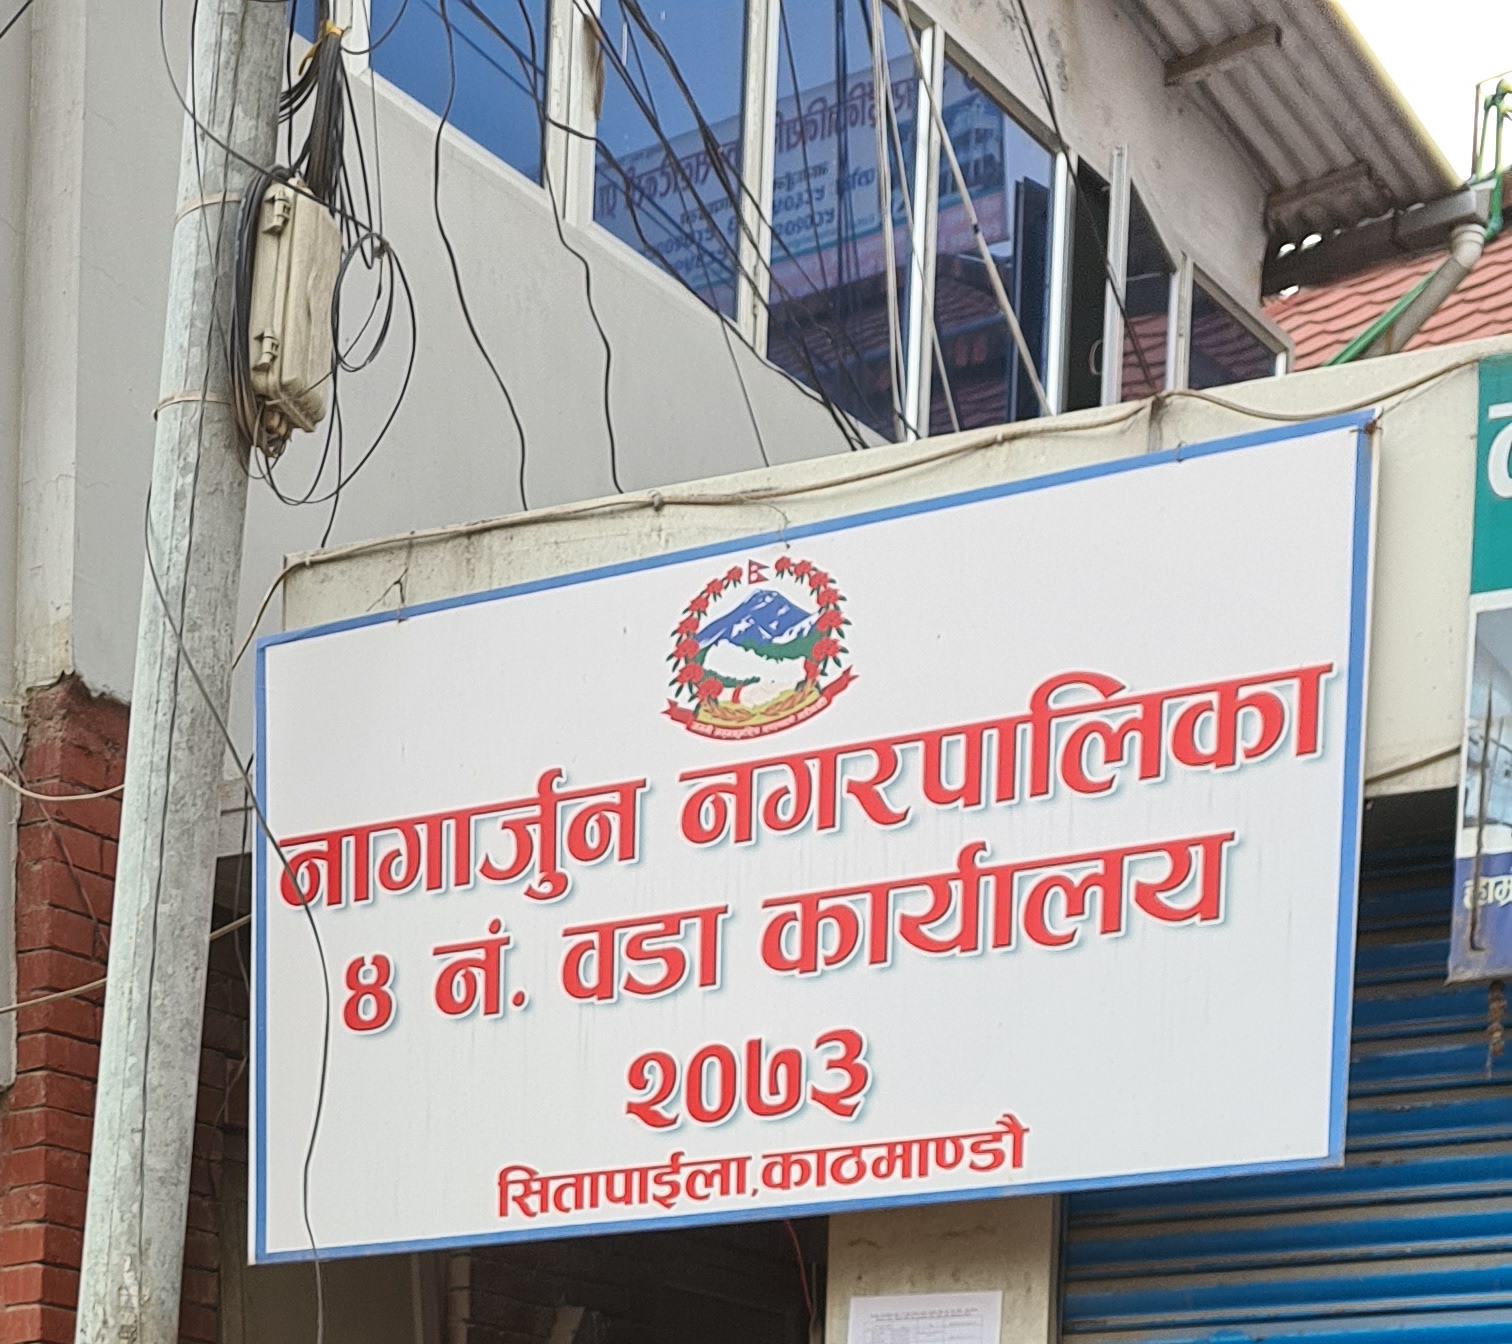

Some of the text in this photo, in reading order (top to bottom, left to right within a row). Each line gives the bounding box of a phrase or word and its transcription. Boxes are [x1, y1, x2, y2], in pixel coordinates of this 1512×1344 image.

[280, 663, 1333, 907] नागार्जुन नगरपालिका
[343, 954, 393, 1032] ४
[561, 904, 728, 1000] वडा
[761, 831, 1235, 974] कार्यालय
[626, 1029, 869, 1128] २०७३
